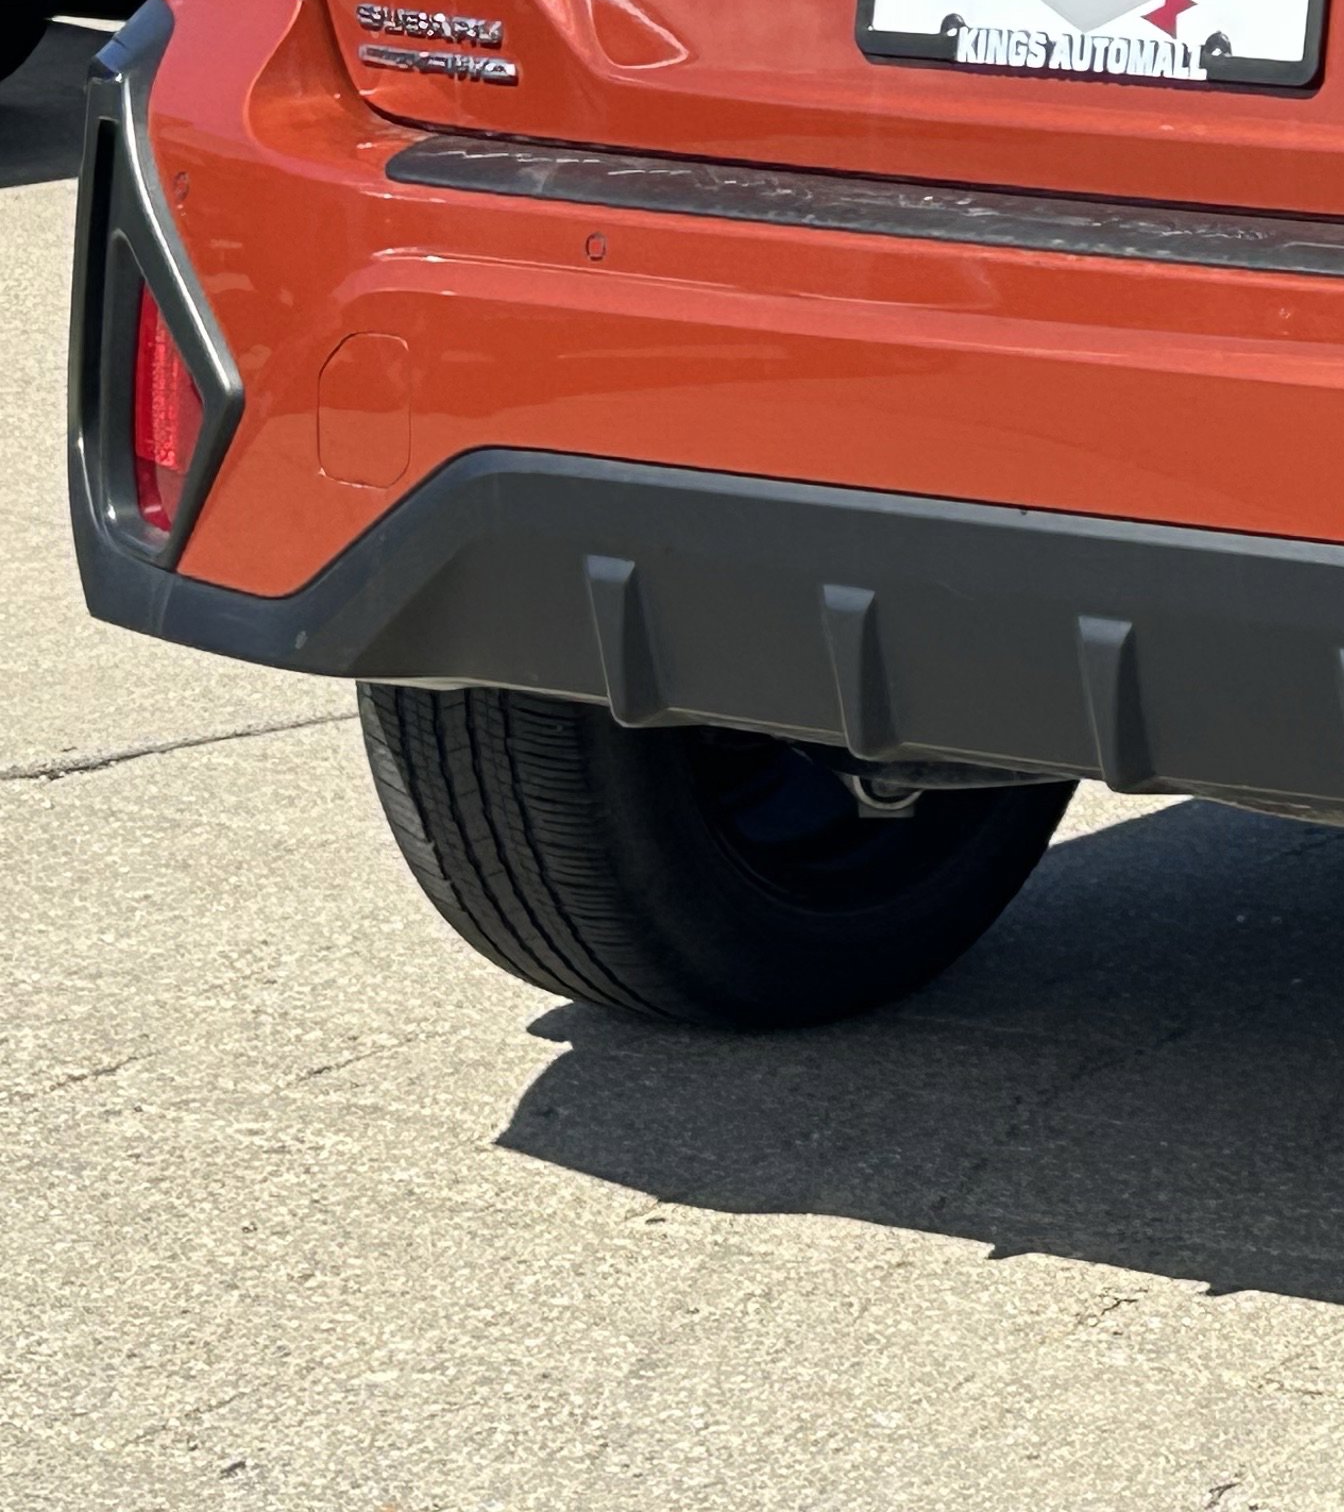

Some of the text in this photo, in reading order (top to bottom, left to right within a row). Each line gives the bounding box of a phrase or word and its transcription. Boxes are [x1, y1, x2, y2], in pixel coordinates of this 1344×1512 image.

[356, 3, 503, 48] SUBARU
[957, 27, 1208, 81] KINGS AUTOMALL
